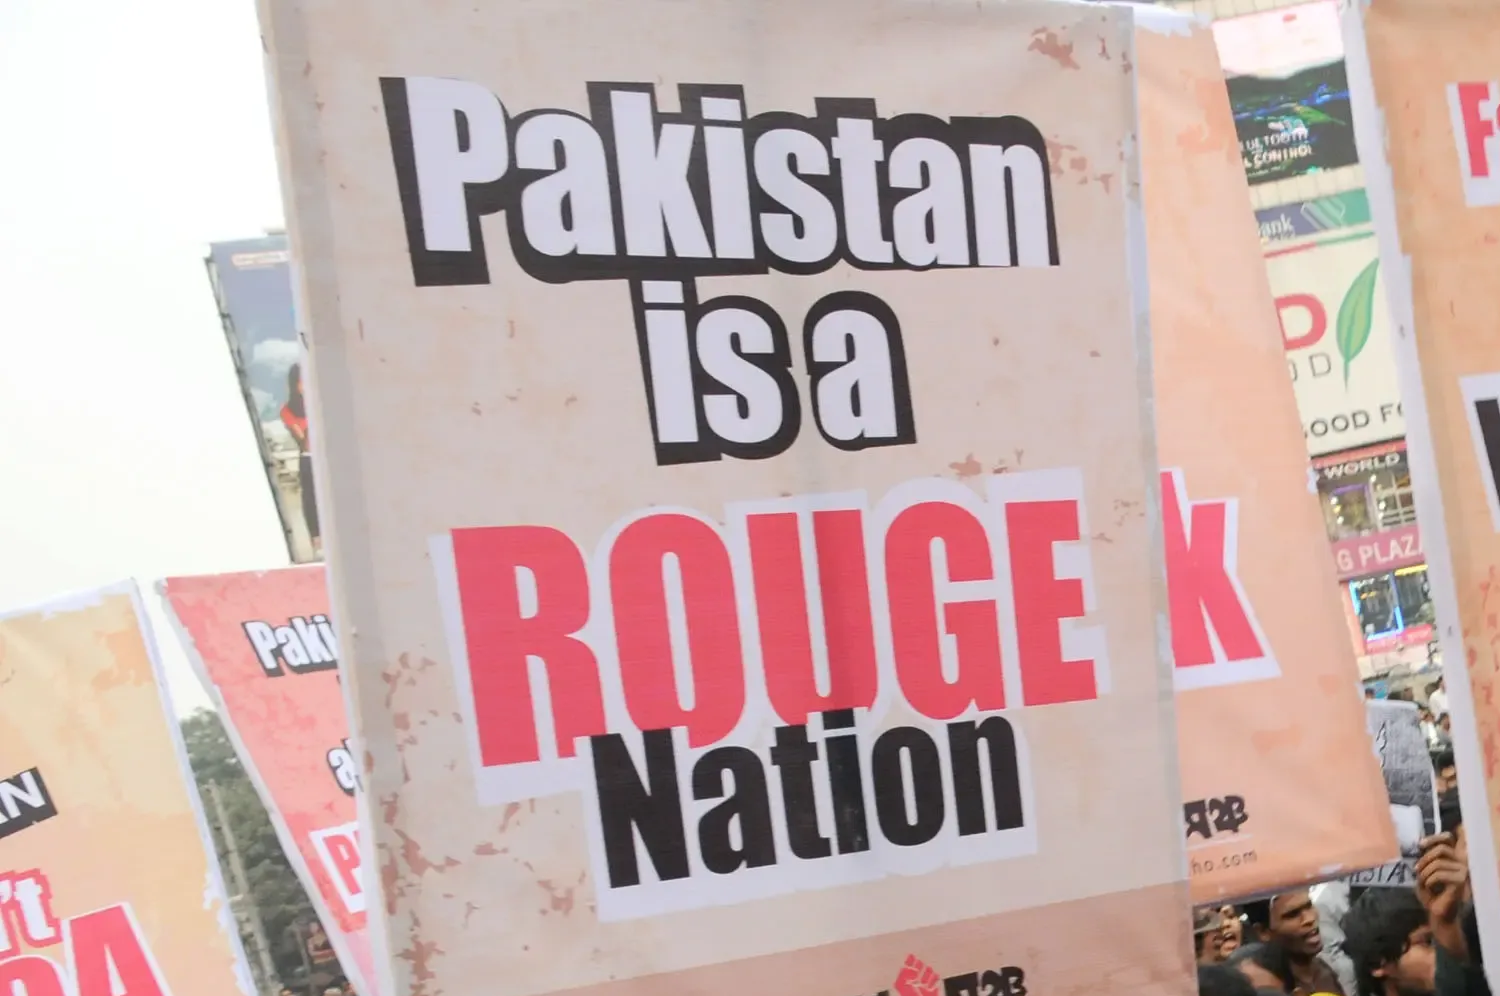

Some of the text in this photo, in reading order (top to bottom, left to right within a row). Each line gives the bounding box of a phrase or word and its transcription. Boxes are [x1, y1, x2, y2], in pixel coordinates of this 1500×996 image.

[382, 76, 1060, 286] Pakistan
[1258, 213, 1295, 237] ank
[632, 277, 917, 466] is a
[1304, 409, 1370, 439] OOD
[1324, 452, 1401, 480] WORLD
[447, 495, 1100, 768] ROUGE
[590, 709, 1024, 888] Nation
